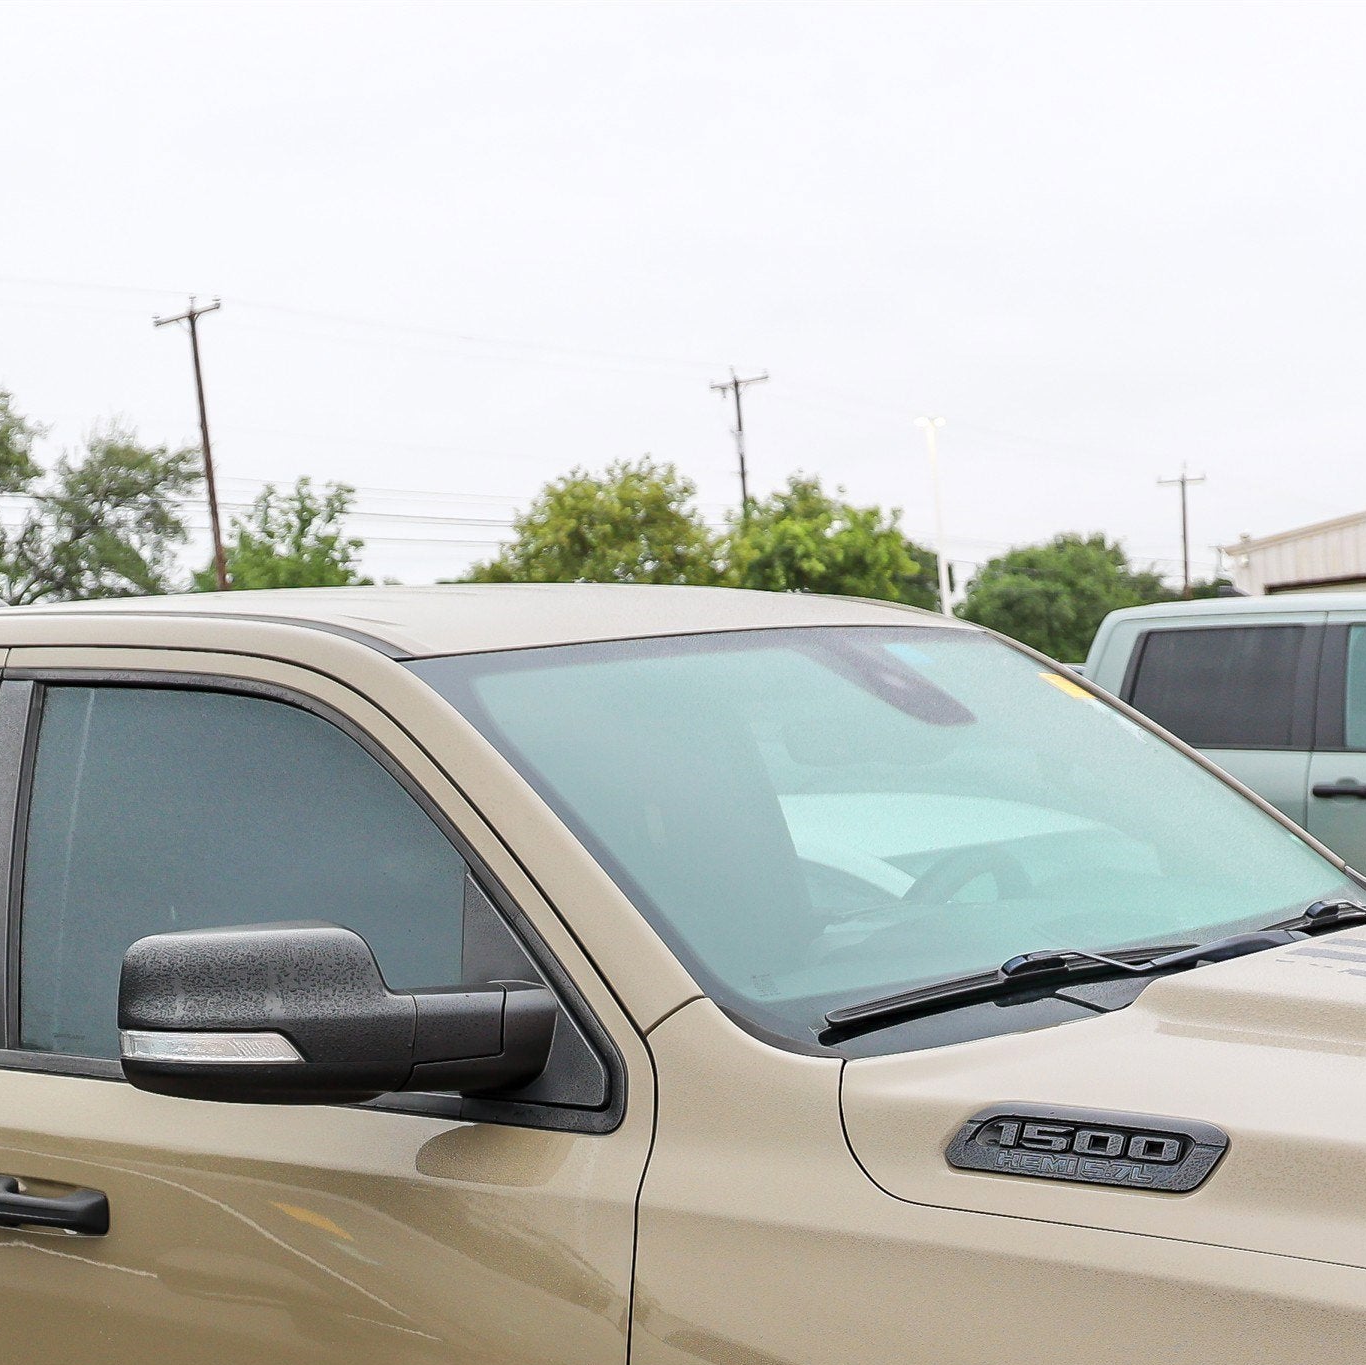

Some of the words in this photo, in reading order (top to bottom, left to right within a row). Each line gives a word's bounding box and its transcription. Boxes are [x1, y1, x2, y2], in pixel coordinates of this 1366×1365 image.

[994, 1121, 1180, 1163] 1500
[994, 1150, 1080, 1175] HEMI
[1081, 1158, 1153, 1183] 5.7L
